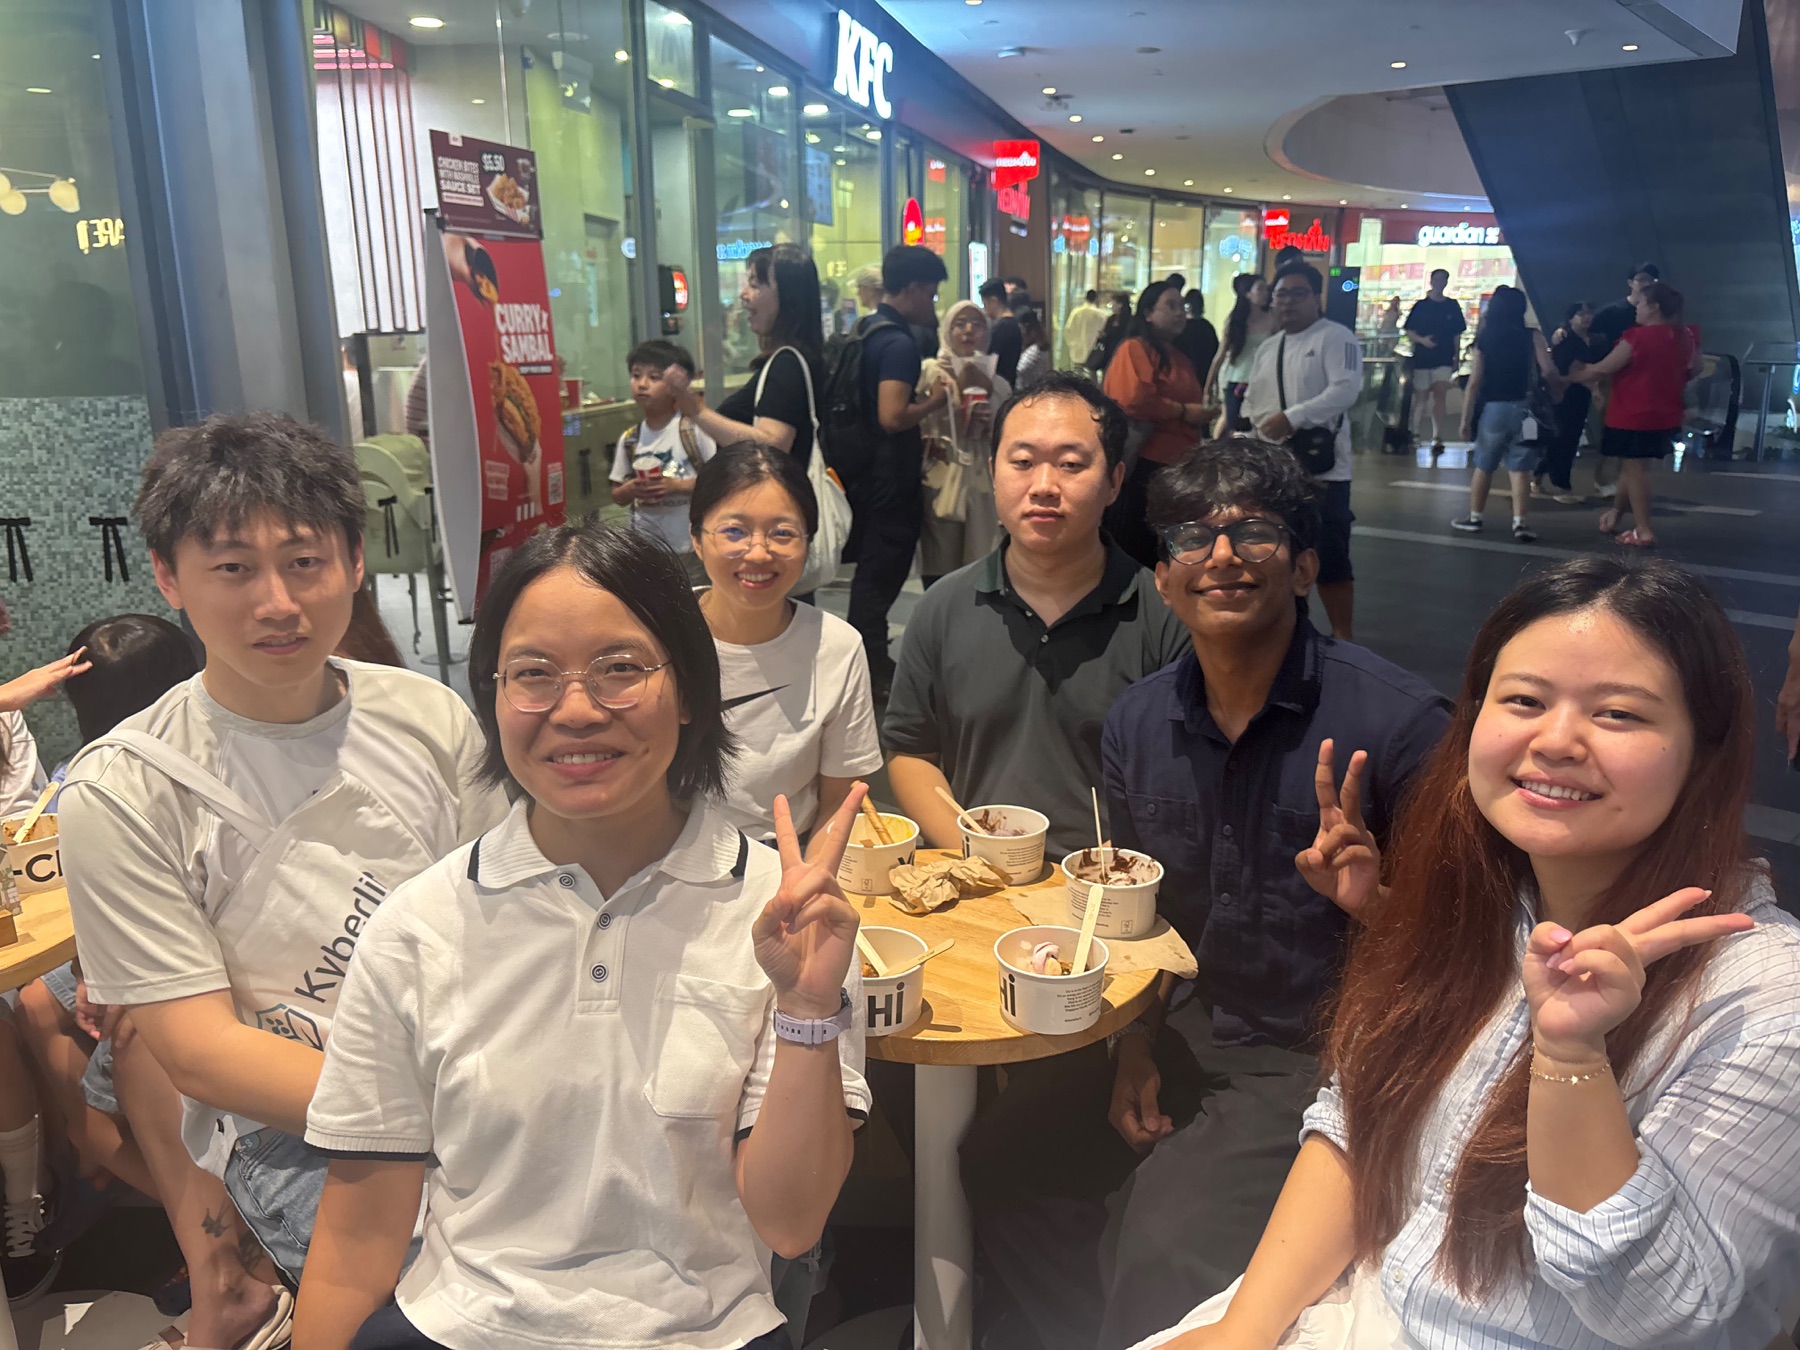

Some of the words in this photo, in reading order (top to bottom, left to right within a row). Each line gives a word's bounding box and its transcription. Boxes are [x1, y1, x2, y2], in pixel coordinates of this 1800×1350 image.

[833, 9, 894, 119] KFC
[1418, 222, 1485, 247] guardian
[495, 303, 541, 333] CURRY
[501, 334, 554, 363] SAMBAL
[867, 981, 905, 1028] Hi
[999, 973, 1017, 1017] Hi
